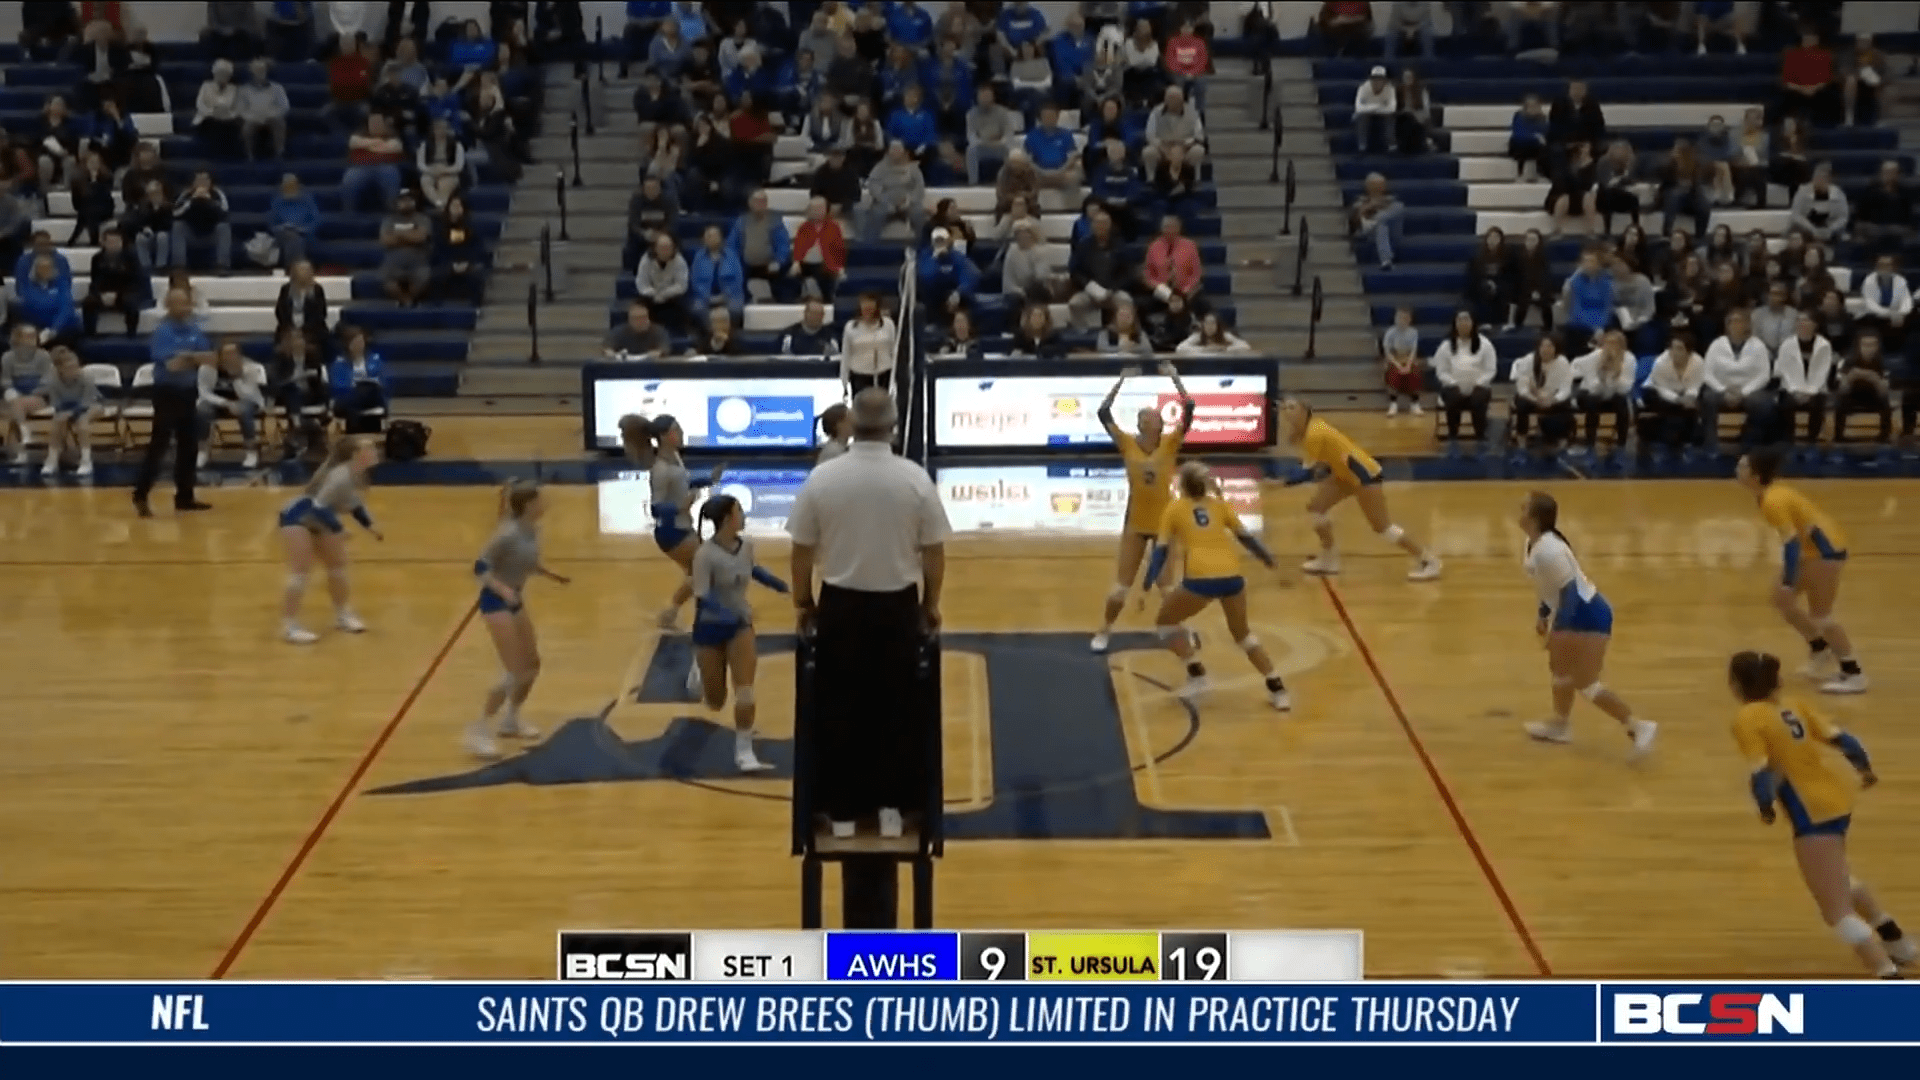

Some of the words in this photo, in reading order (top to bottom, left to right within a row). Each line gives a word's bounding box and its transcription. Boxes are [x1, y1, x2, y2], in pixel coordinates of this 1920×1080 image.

[951, 409, 1029, 433] meijer
[1193, 507, 1209, 527] 6
[1780, 709, 1805, 740] 5
